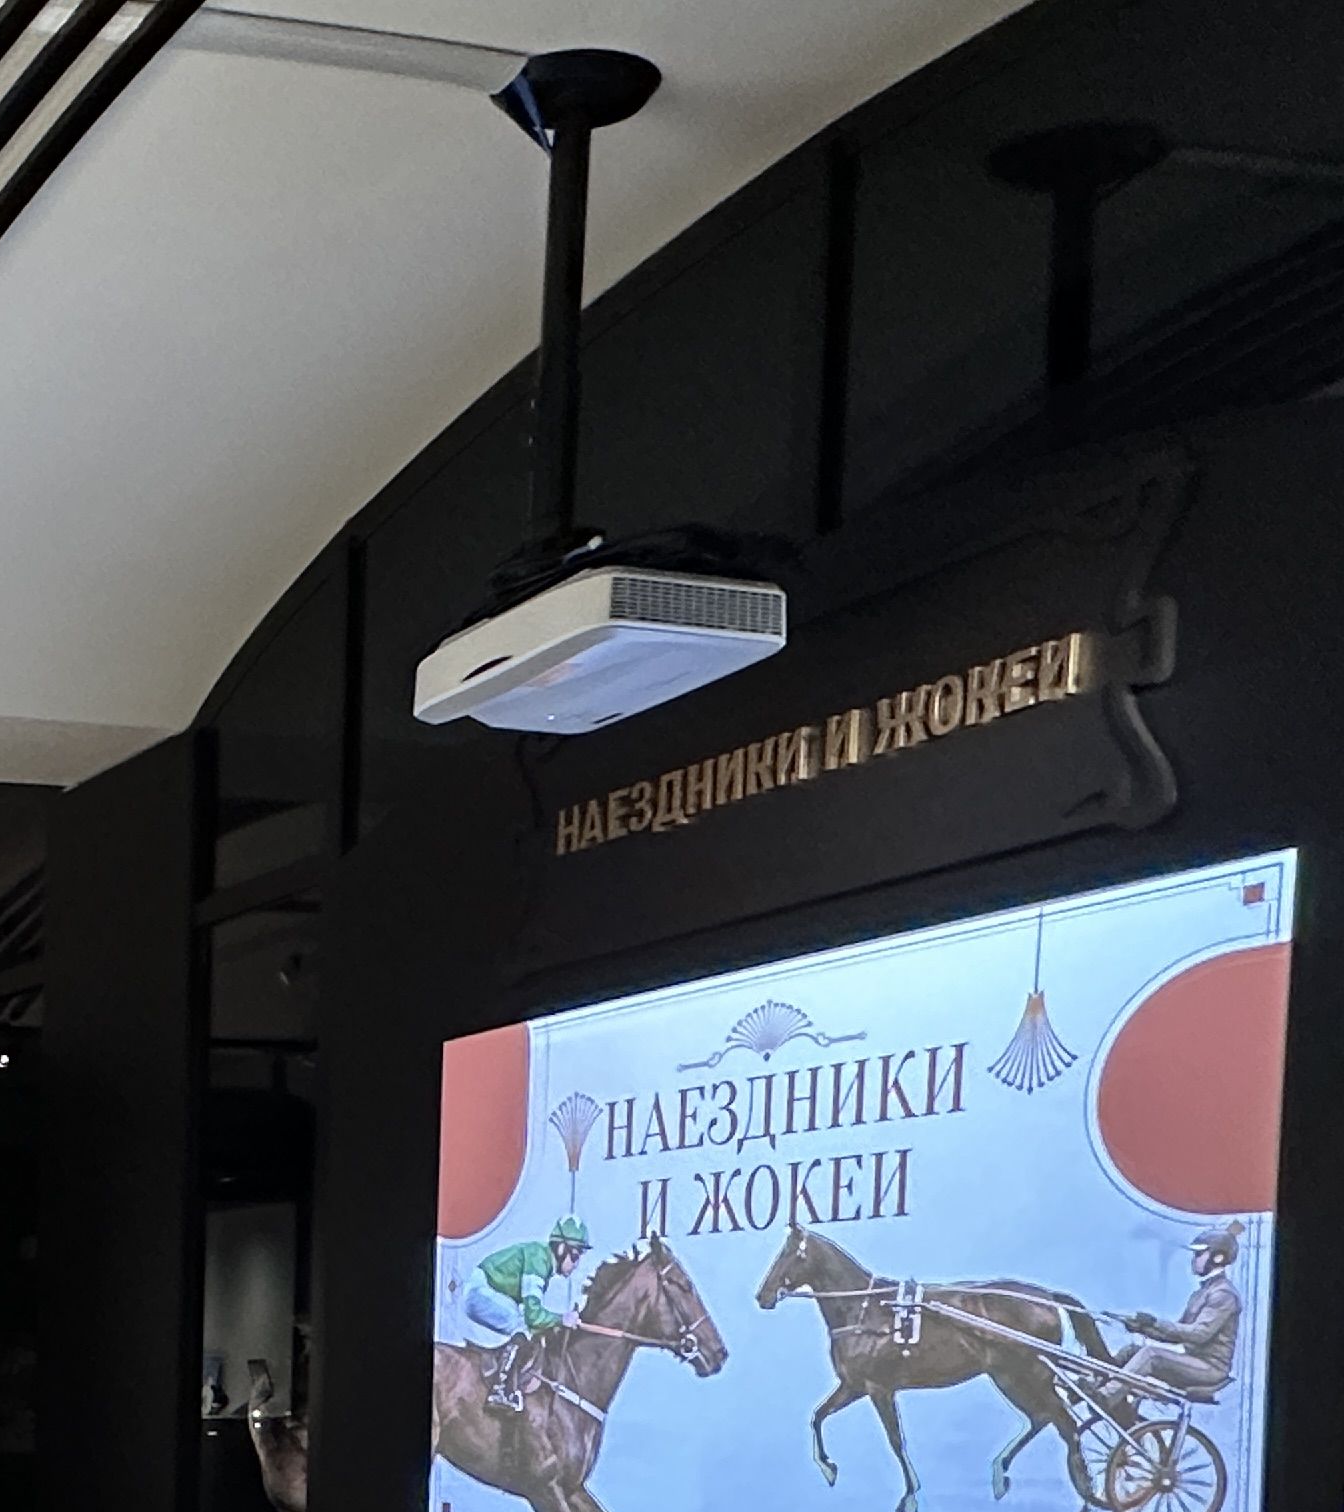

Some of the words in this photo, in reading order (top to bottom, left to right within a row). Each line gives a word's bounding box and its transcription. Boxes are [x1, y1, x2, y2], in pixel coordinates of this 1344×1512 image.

[556, 726, 816, 856] НАЕЗДНИКИ
[823, 708, 868, 770] И
[871, 632, 1088, 756] ЖОКЕИ
[603, 1041, 969, 1161] НАЕЗДНИКИ
[638, 1177, 672, 1240] И
[687, 1148, 912, 1236] ЖОКЕИ
